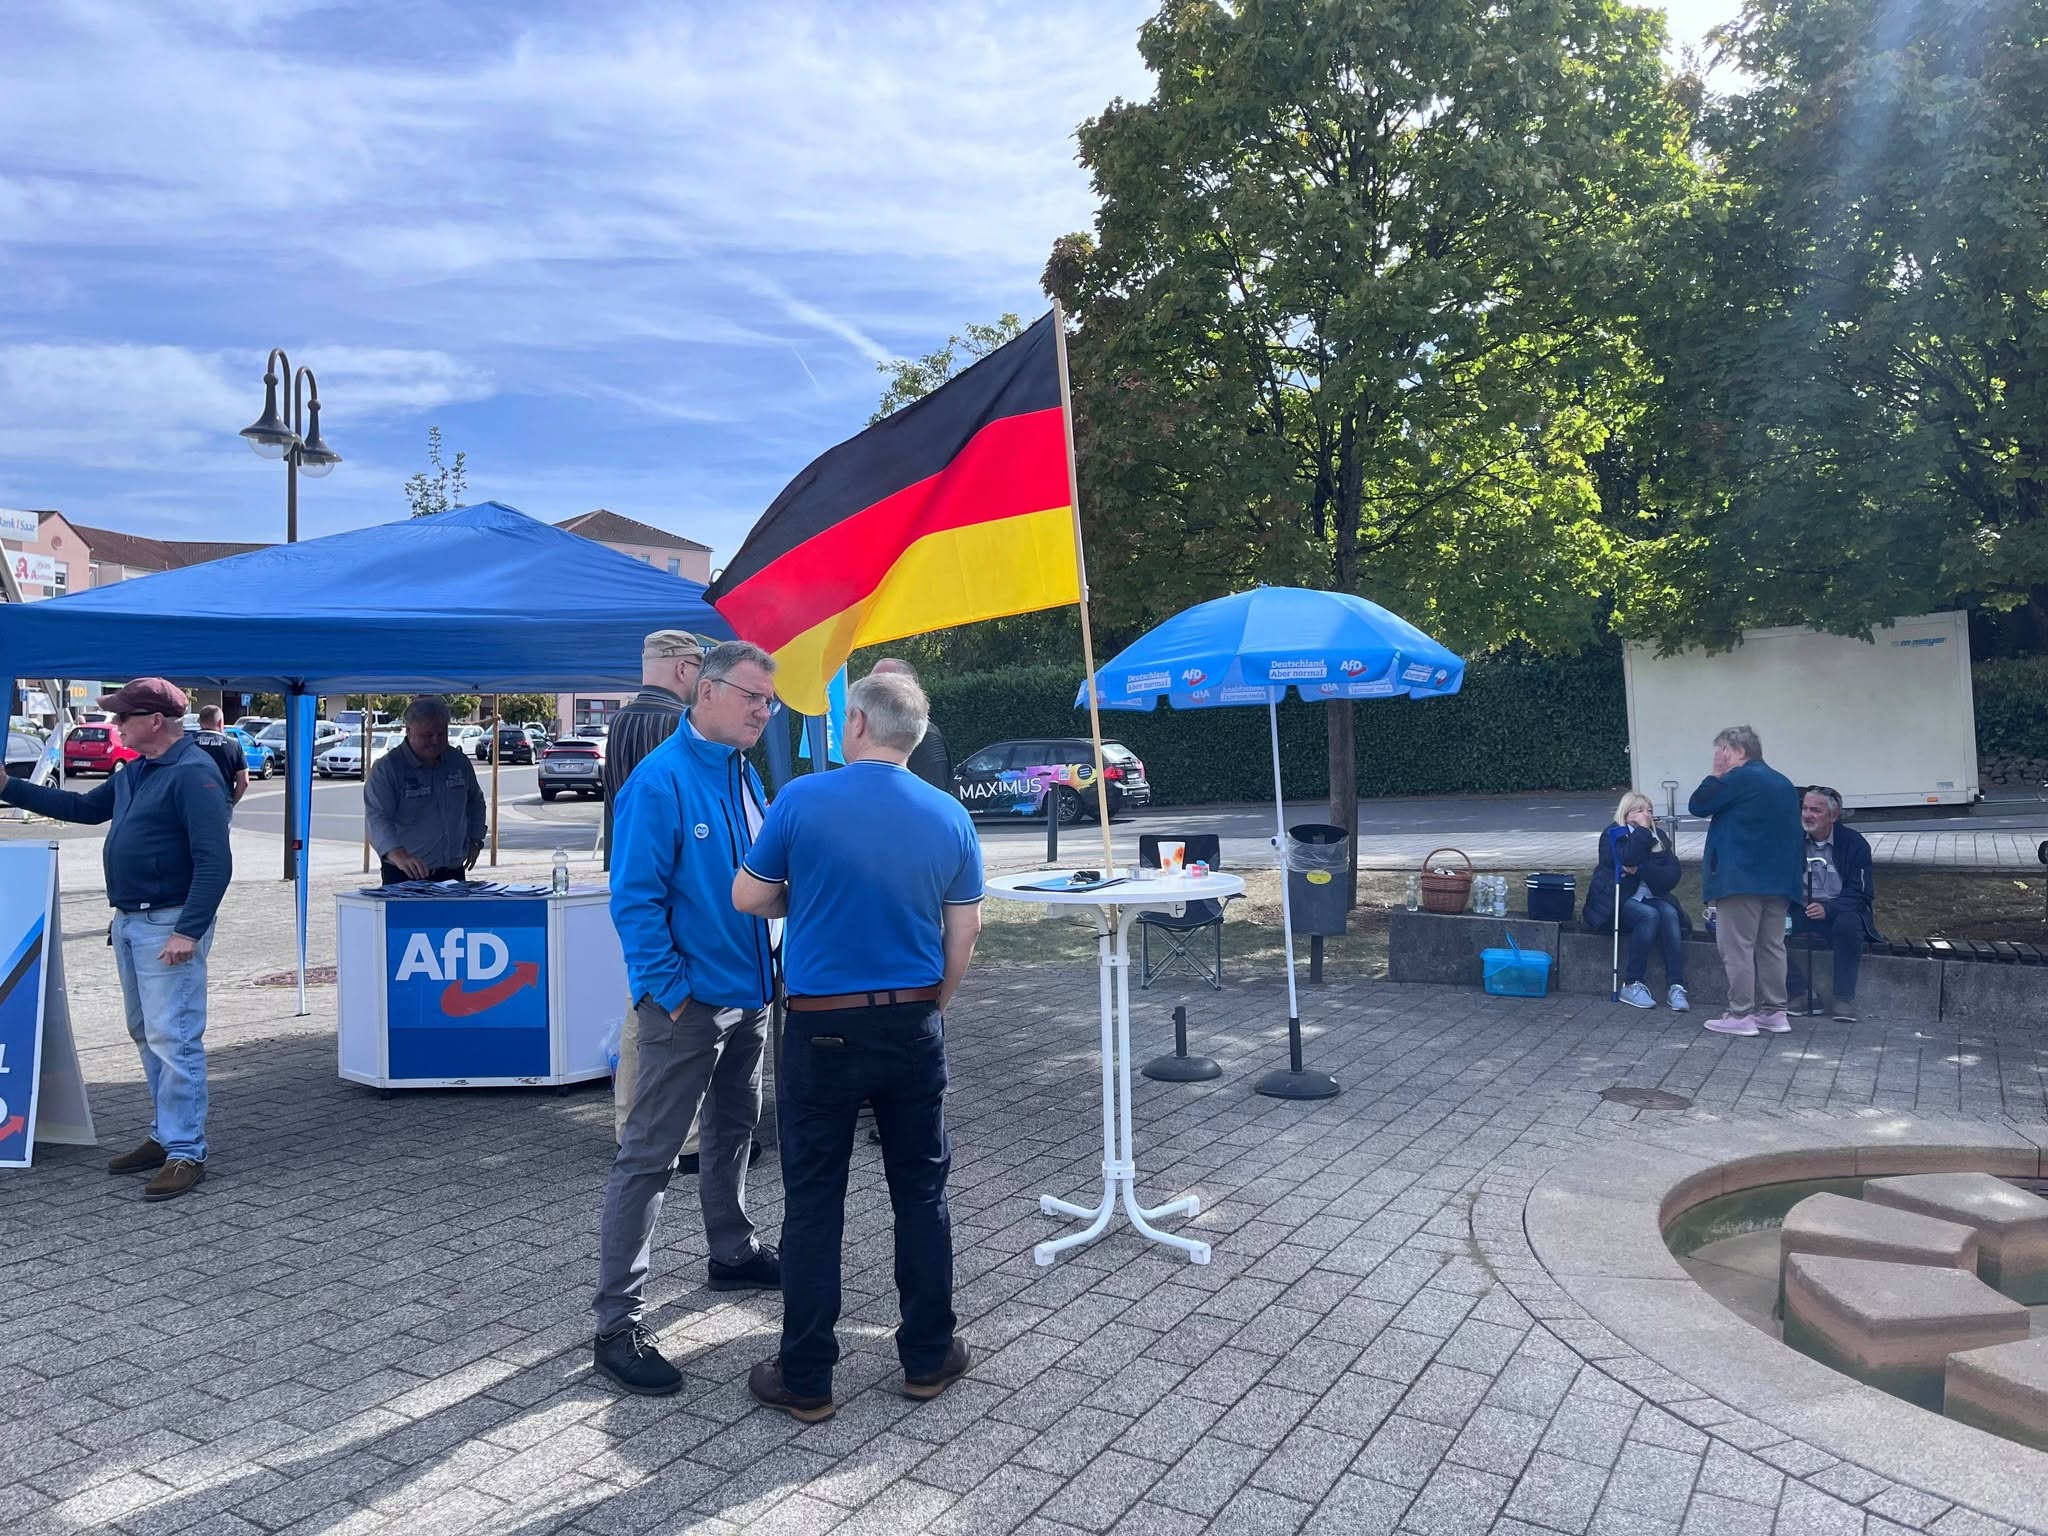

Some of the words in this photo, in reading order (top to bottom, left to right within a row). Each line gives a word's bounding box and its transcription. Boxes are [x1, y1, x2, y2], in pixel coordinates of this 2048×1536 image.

[1340, 660, 1362, 671] AfD
[1182, 669, 1202, 680] AfD
[1271, 669, 1291, 678] Aber
[1128, 681, 1143, 692] Aber
[960, 778, 1042, 800] MAXIMUS
[395, 927, 510, 981] AfD
